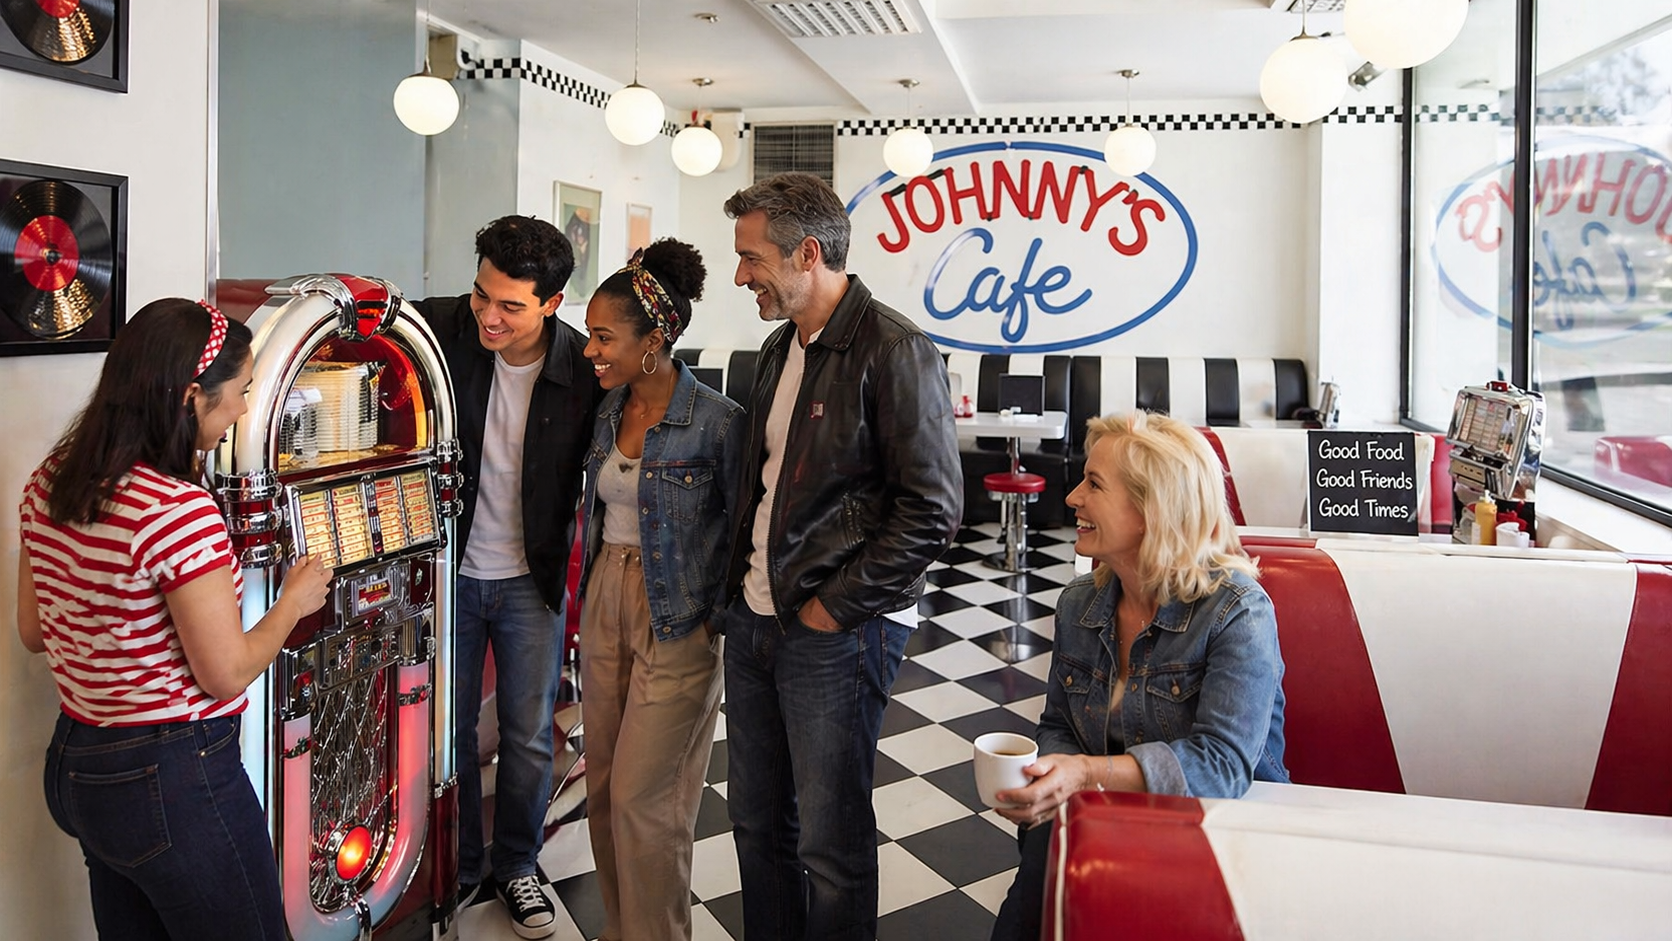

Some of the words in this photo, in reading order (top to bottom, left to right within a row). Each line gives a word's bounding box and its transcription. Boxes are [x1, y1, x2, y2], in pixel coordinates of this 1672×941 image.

[877, 159, 1166, 256] JOHNNY'S
[923, 227, 1093, 343] Cafe
[1318, 439, 1360, 460] Good
[1366, 440, 1405, 461] Food
[1316, 468, 1355, 488] Good
[1360, 469, 1413, 490] Friends
[1318, 497, 1360, 518] Good
[1364, 498, 1409, 519] Times
